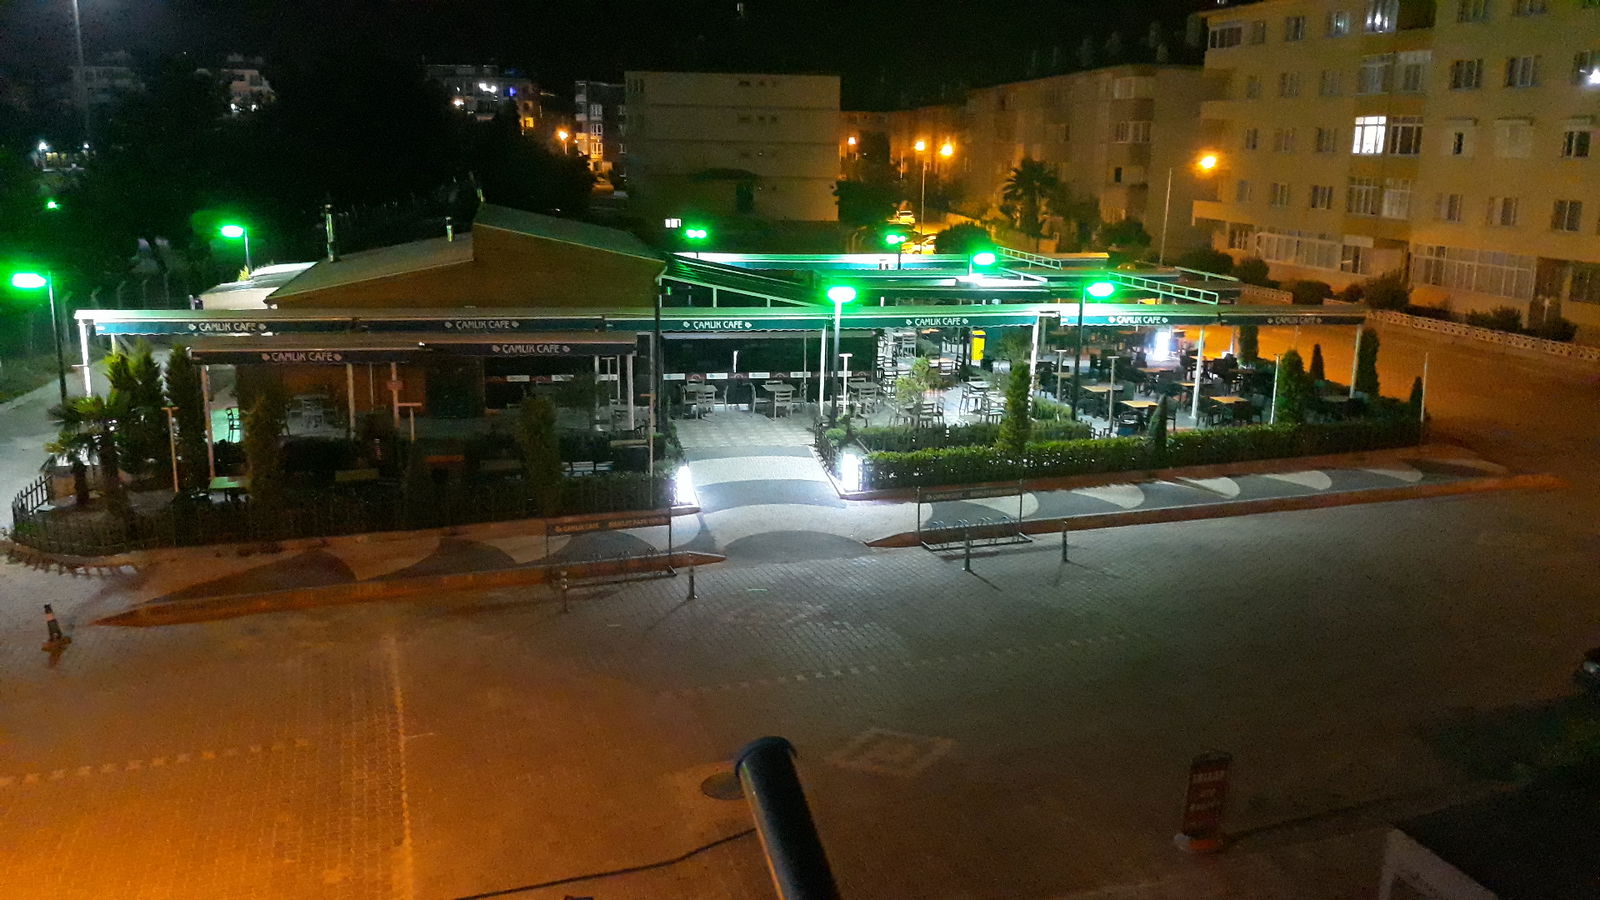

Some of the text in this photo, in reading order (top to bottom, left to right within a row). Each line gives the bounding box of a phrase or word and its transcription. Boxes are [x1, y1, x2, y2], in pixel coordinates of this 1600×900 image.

[723, 320, 743, 329] CAFE
[942, 317, 961, 326] CAFE
[1142, 316, 1161, 324] CAFE
[233, 322, 257, 331] CAFE
[488, 320, 510, 330] CAFE
[536, 344, 561, 354] CAFE
[308, 352, 334, 362] CAFE
